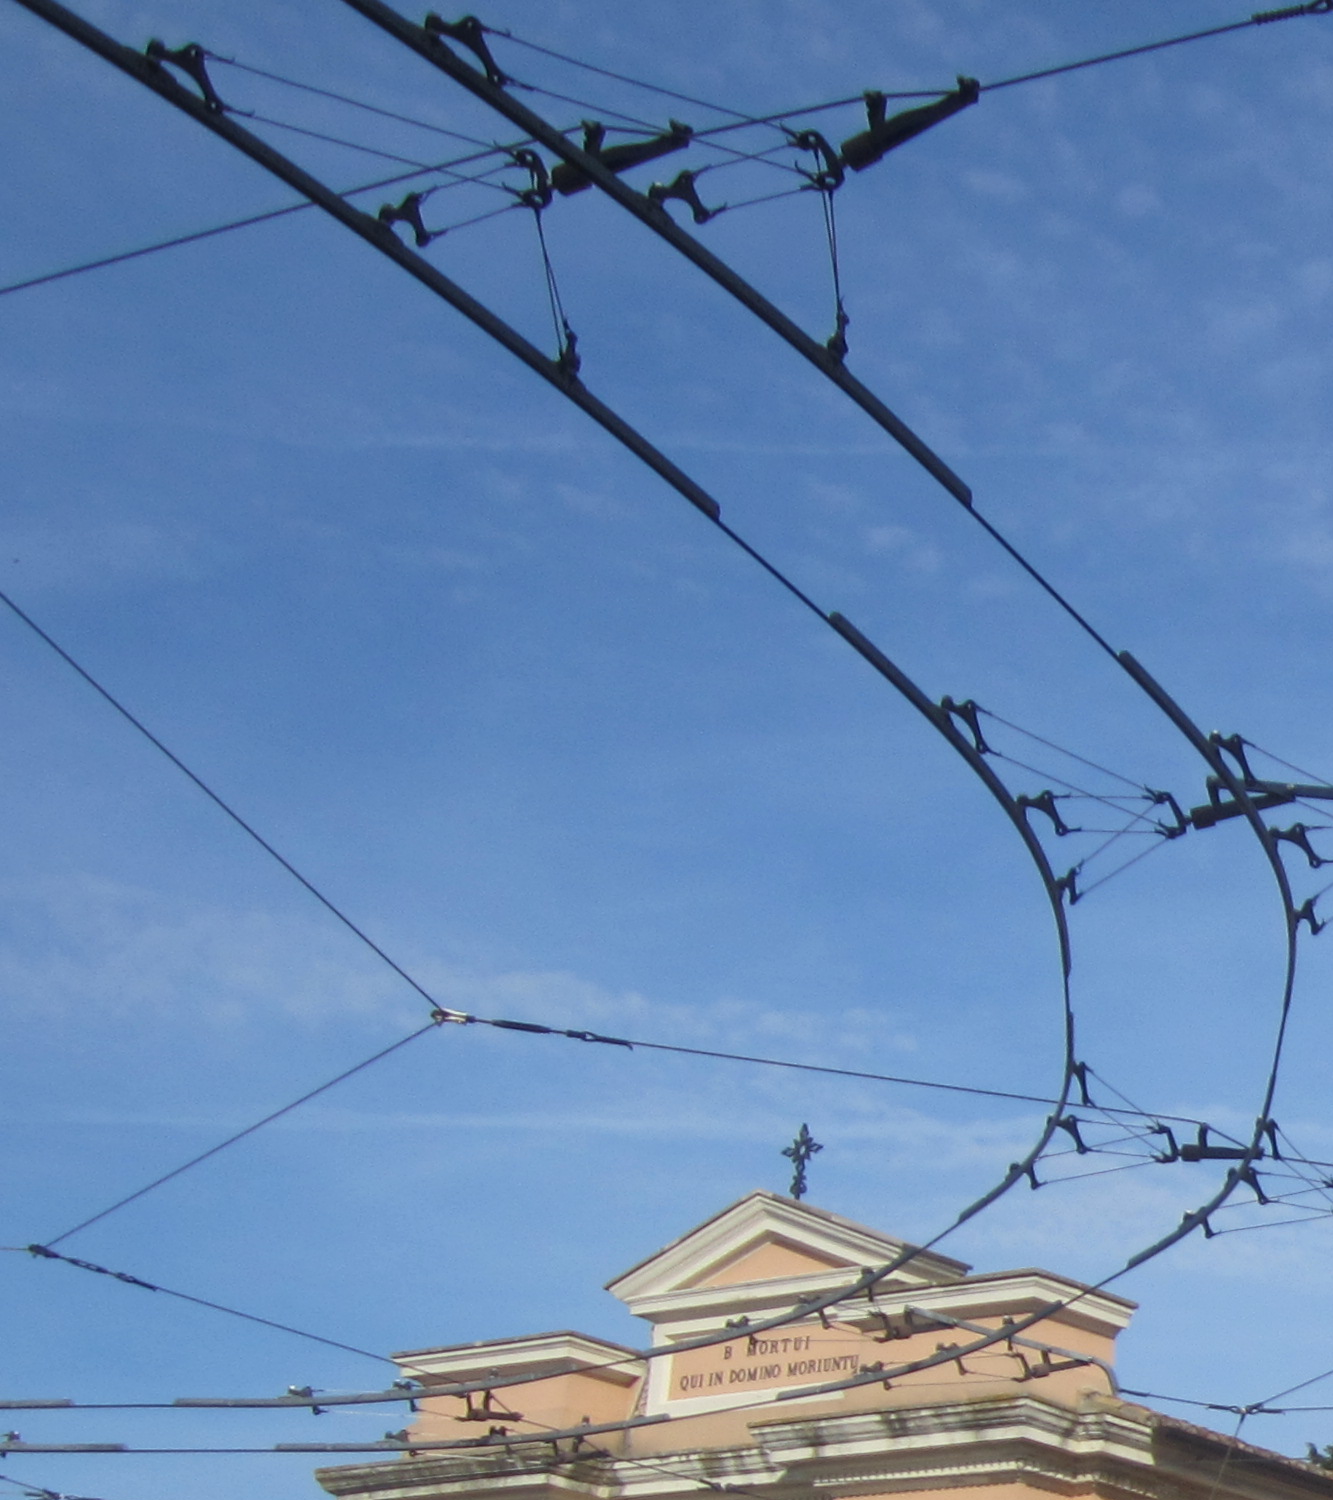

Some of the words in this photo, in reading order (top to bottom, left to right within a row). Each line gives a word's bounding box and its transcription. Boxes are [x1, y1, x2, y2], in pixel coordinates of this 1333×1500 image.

[680, 1374, 704, 1391] QUI
[708, 1372, 723, 1386] IN
[729, 1364, 781, 1384] DOMINO
